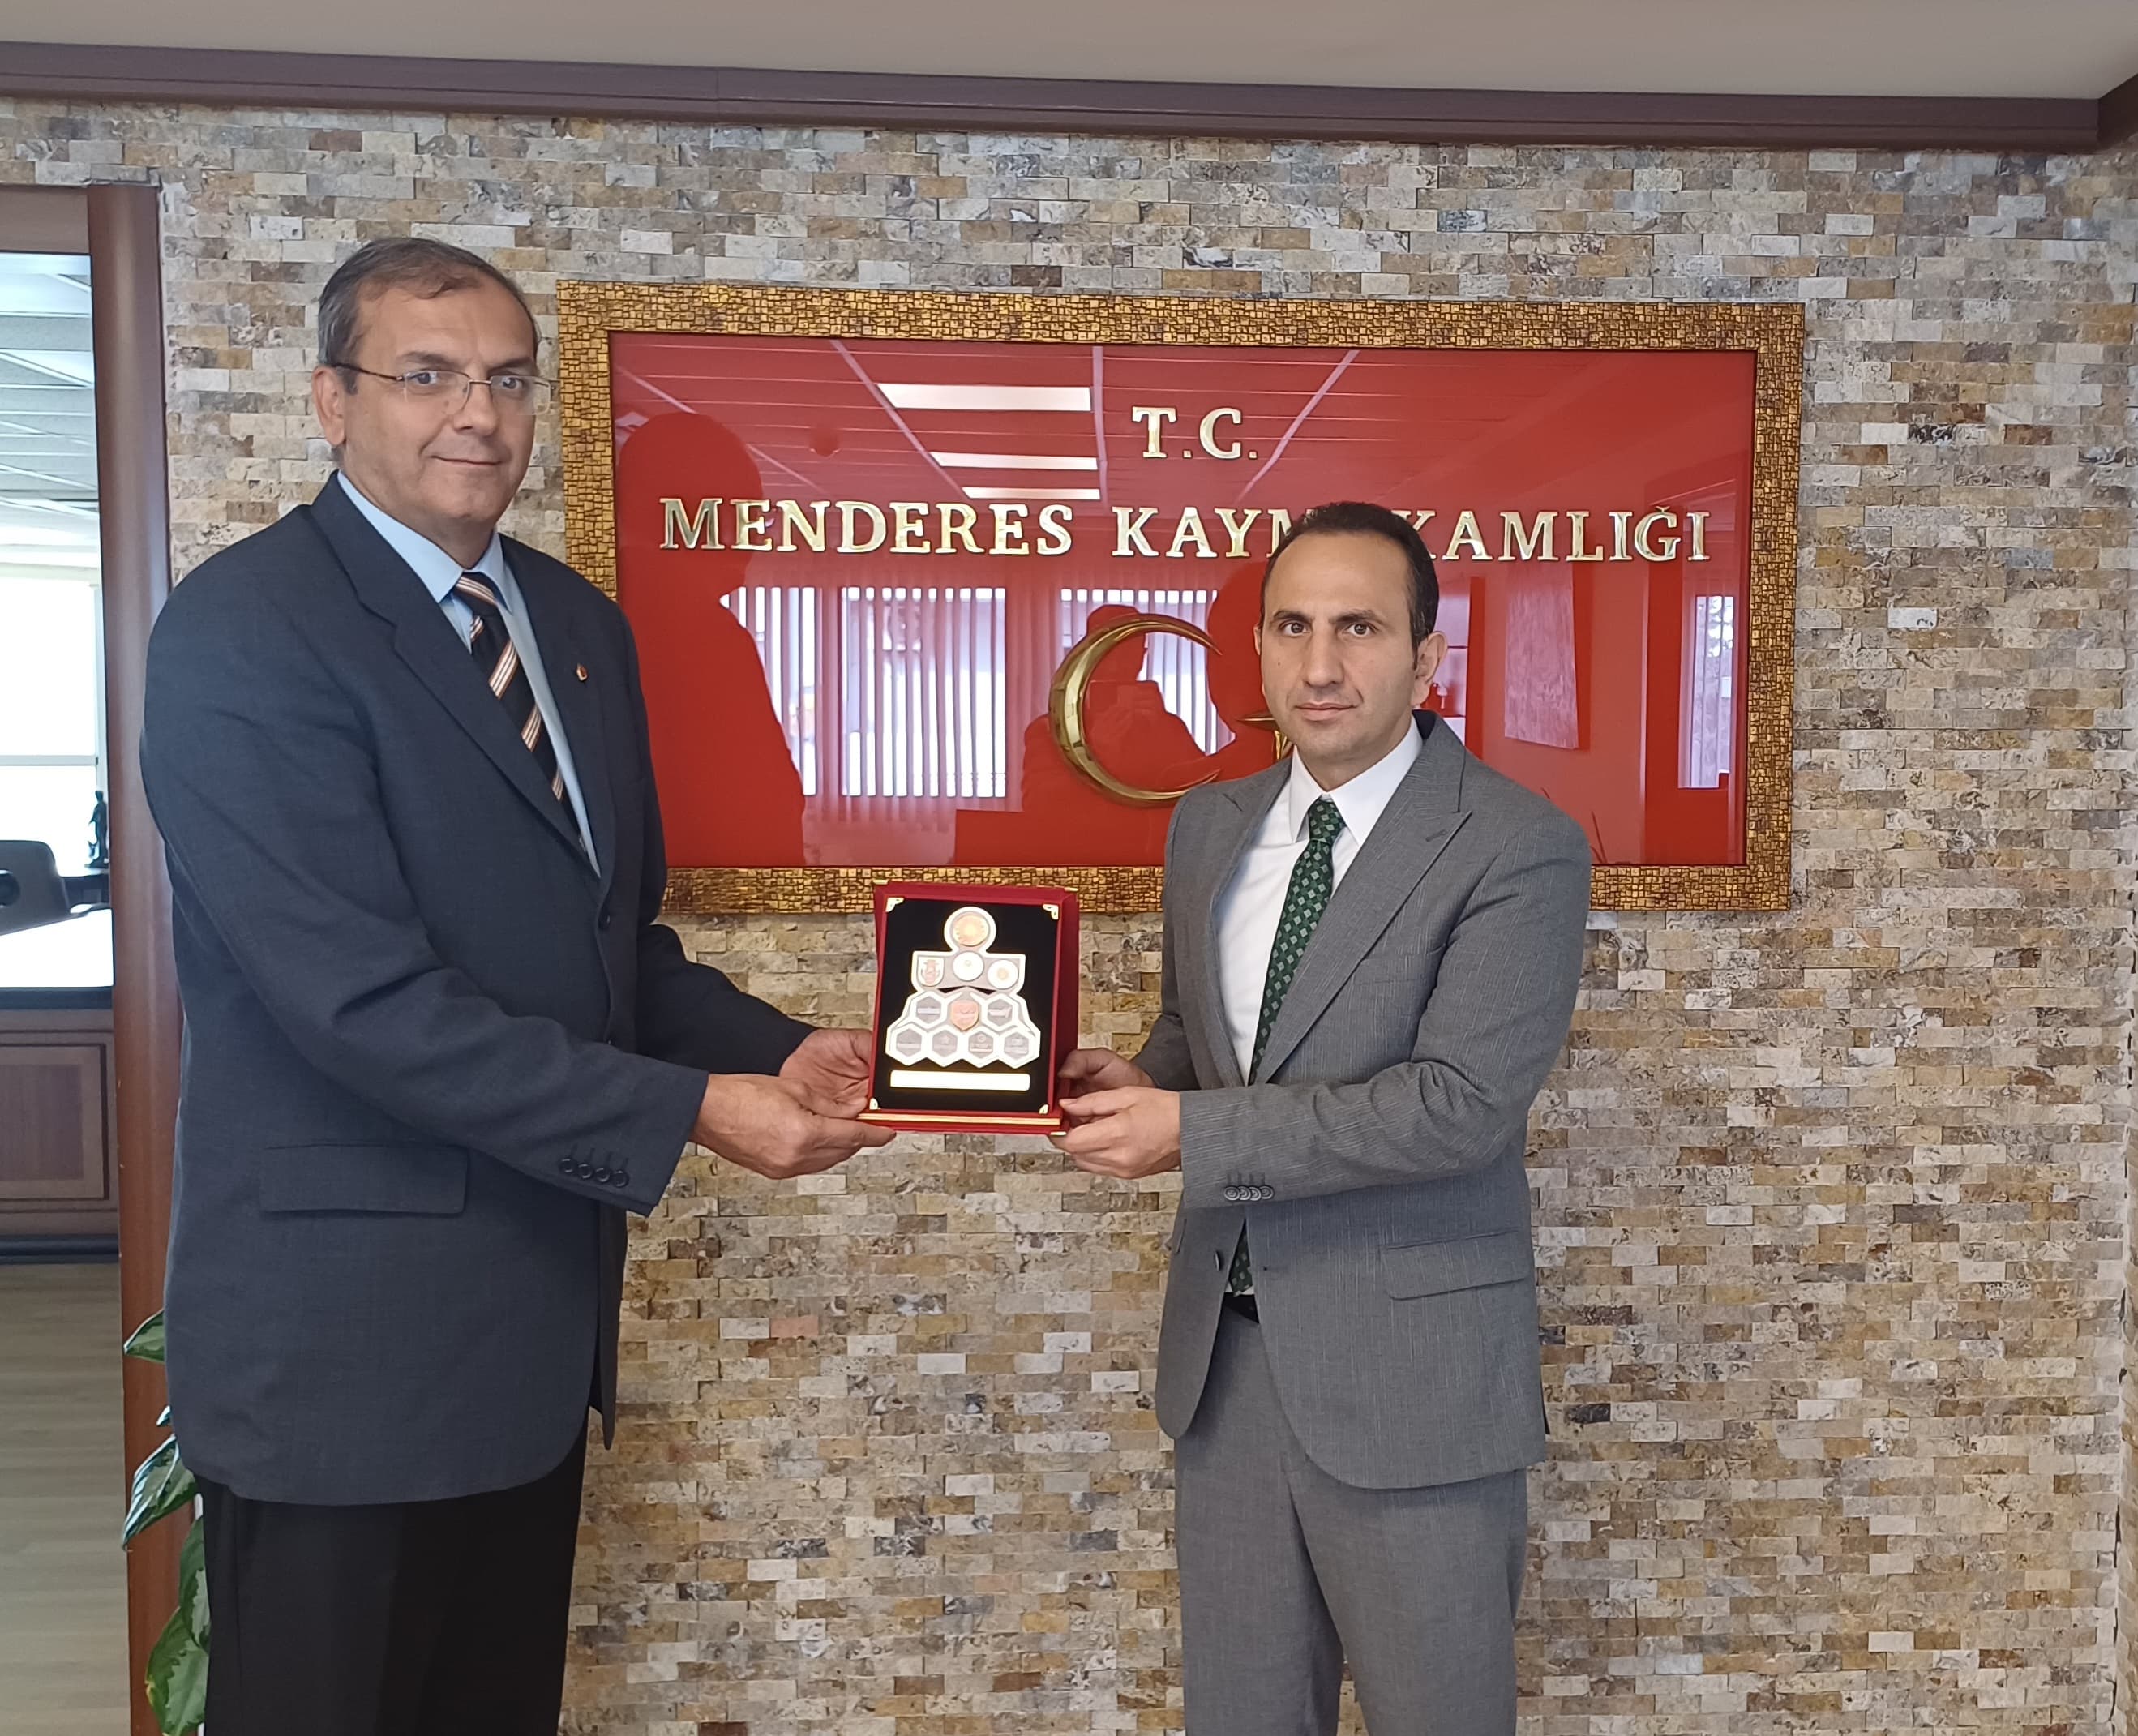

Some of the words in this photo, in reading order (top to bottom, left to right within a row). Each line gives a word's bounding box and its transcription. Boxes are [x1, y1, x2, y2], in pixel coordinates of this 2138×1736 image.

[1132, 405, 1258, 460] T.C.
[659, 497, 1073, 555] MENDERES
[1111, 505, 1711, 562] KAYAMLIĞI
